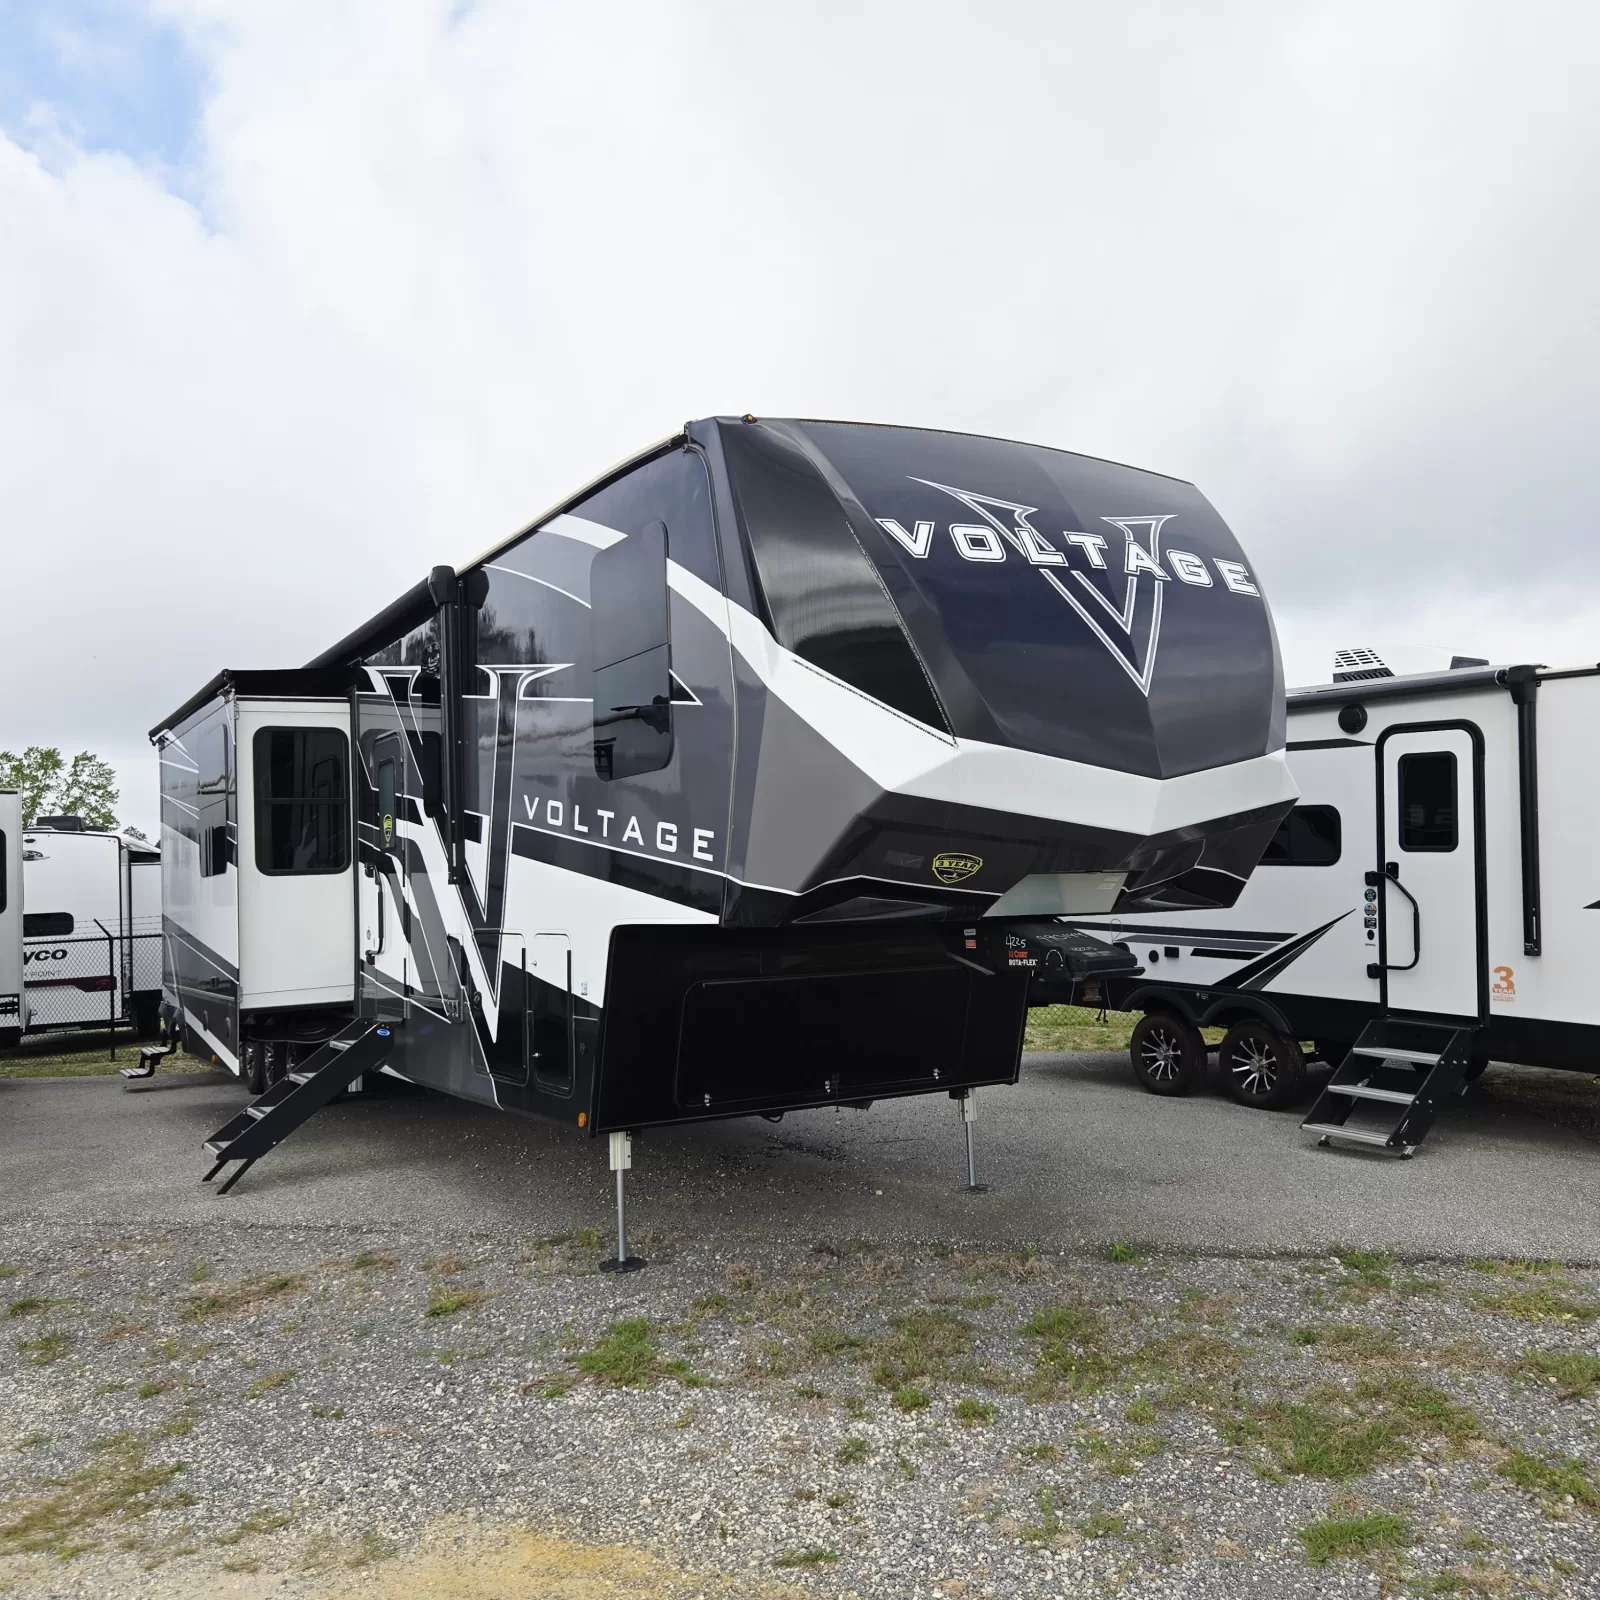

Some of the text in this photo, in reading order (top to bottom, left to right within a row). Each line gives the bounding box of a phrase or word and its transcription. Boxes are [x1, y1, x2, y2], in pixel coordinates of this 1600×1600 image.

[875, 518, 1260, 598] VOLTAGE
[523, 794, 715, 862] VOLTAGE
[948, 861, 977, 871] YEAR
[1005, 934, 1026, 949] 4225
[1493, 966, 1515, 989] 3
